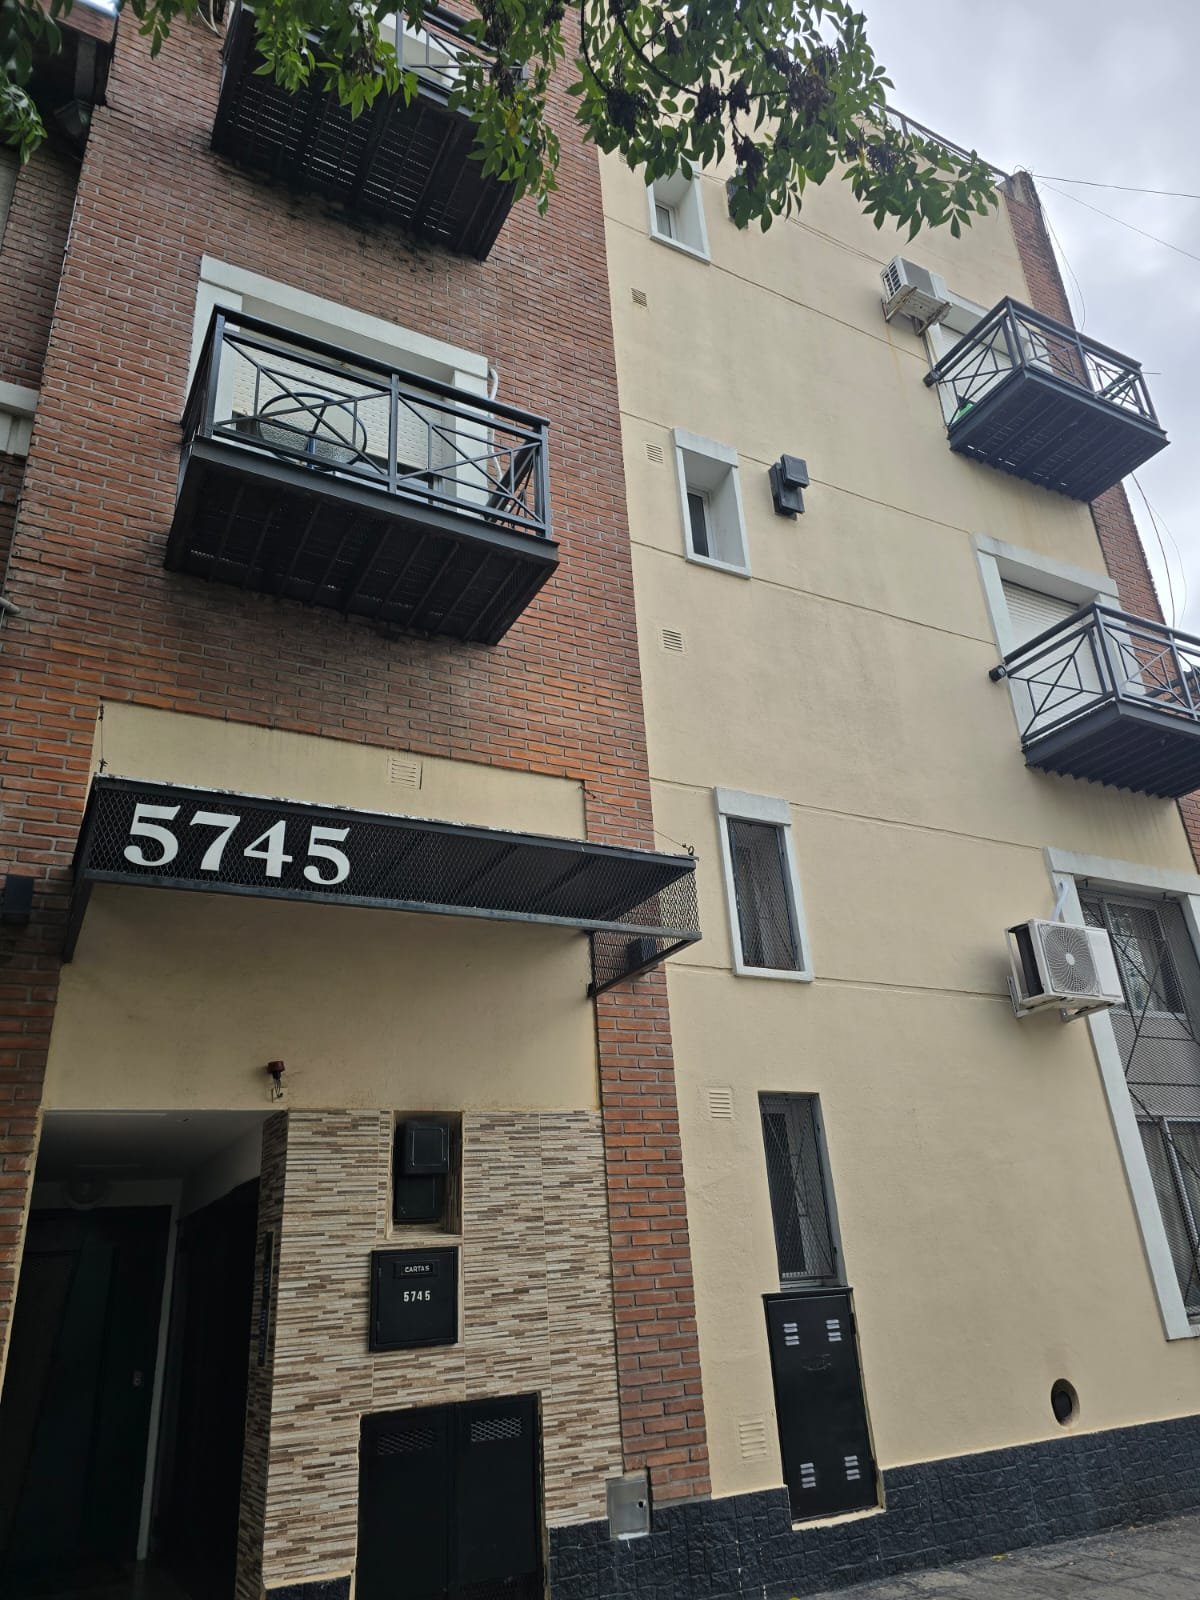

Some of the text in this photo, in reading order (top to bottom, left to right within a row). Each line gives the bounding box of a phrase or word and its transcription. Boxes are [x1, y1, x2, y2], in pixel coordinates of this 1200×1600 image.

[123, 802, 351, 886] 5745
[404, 1265, 430, 1273] CARTAS
[403, 1290, 431, 1302] 5745
